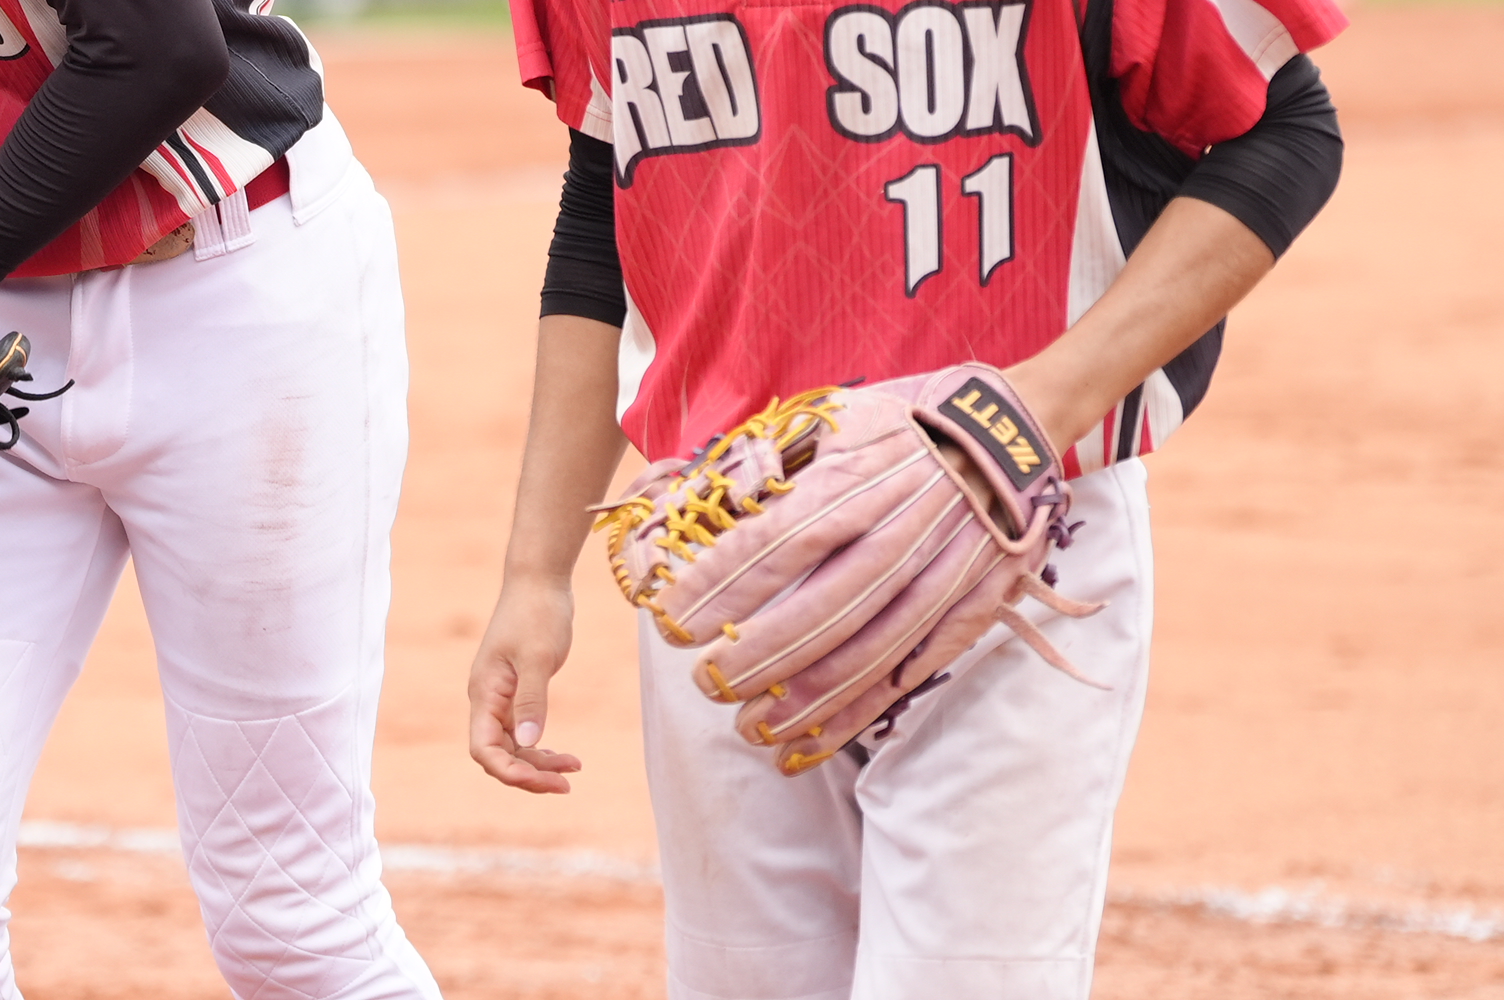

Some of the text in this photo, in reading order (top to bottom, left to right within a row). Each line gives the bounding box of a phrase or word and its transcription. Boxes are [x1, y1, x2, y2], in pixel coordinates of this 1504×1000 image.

[611, 12, 762, 190] RED
[883, 152, 1014, 299] 11
[954, 388, 1042, 475] ZETT
